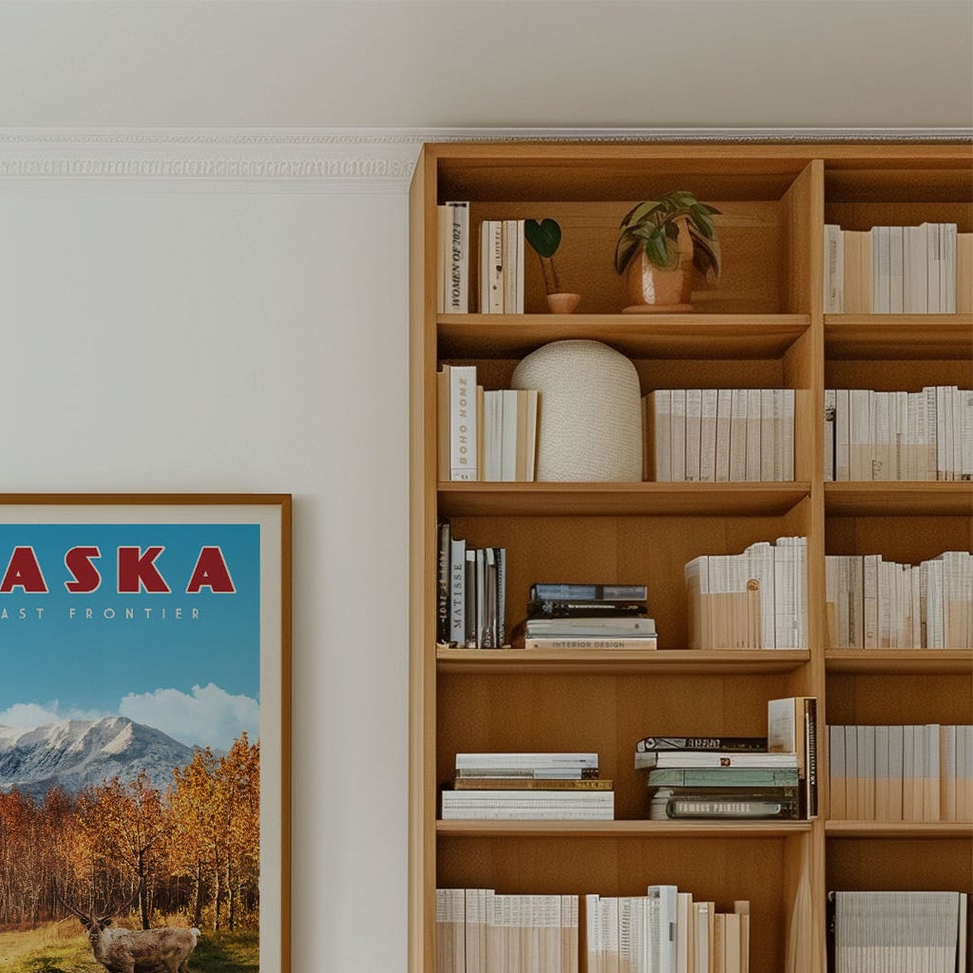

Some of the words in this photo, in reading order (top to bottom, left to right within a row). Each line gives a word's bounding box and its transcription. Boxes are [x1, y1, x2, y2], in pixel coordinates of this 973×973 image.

[451, 245, 461, 262] OF
[451, 264, 461, 307] WOMEN
[459, 377, 468, 418] HOME
[459, 425, 468, 465] BOHO
[69, 608, 200, 620] FRONTIER
[453, 563, 462, 629] MATISSE
[679, 803, 710, 812] FAMOUS
[713, 803, 750, 812] PAINTERS
